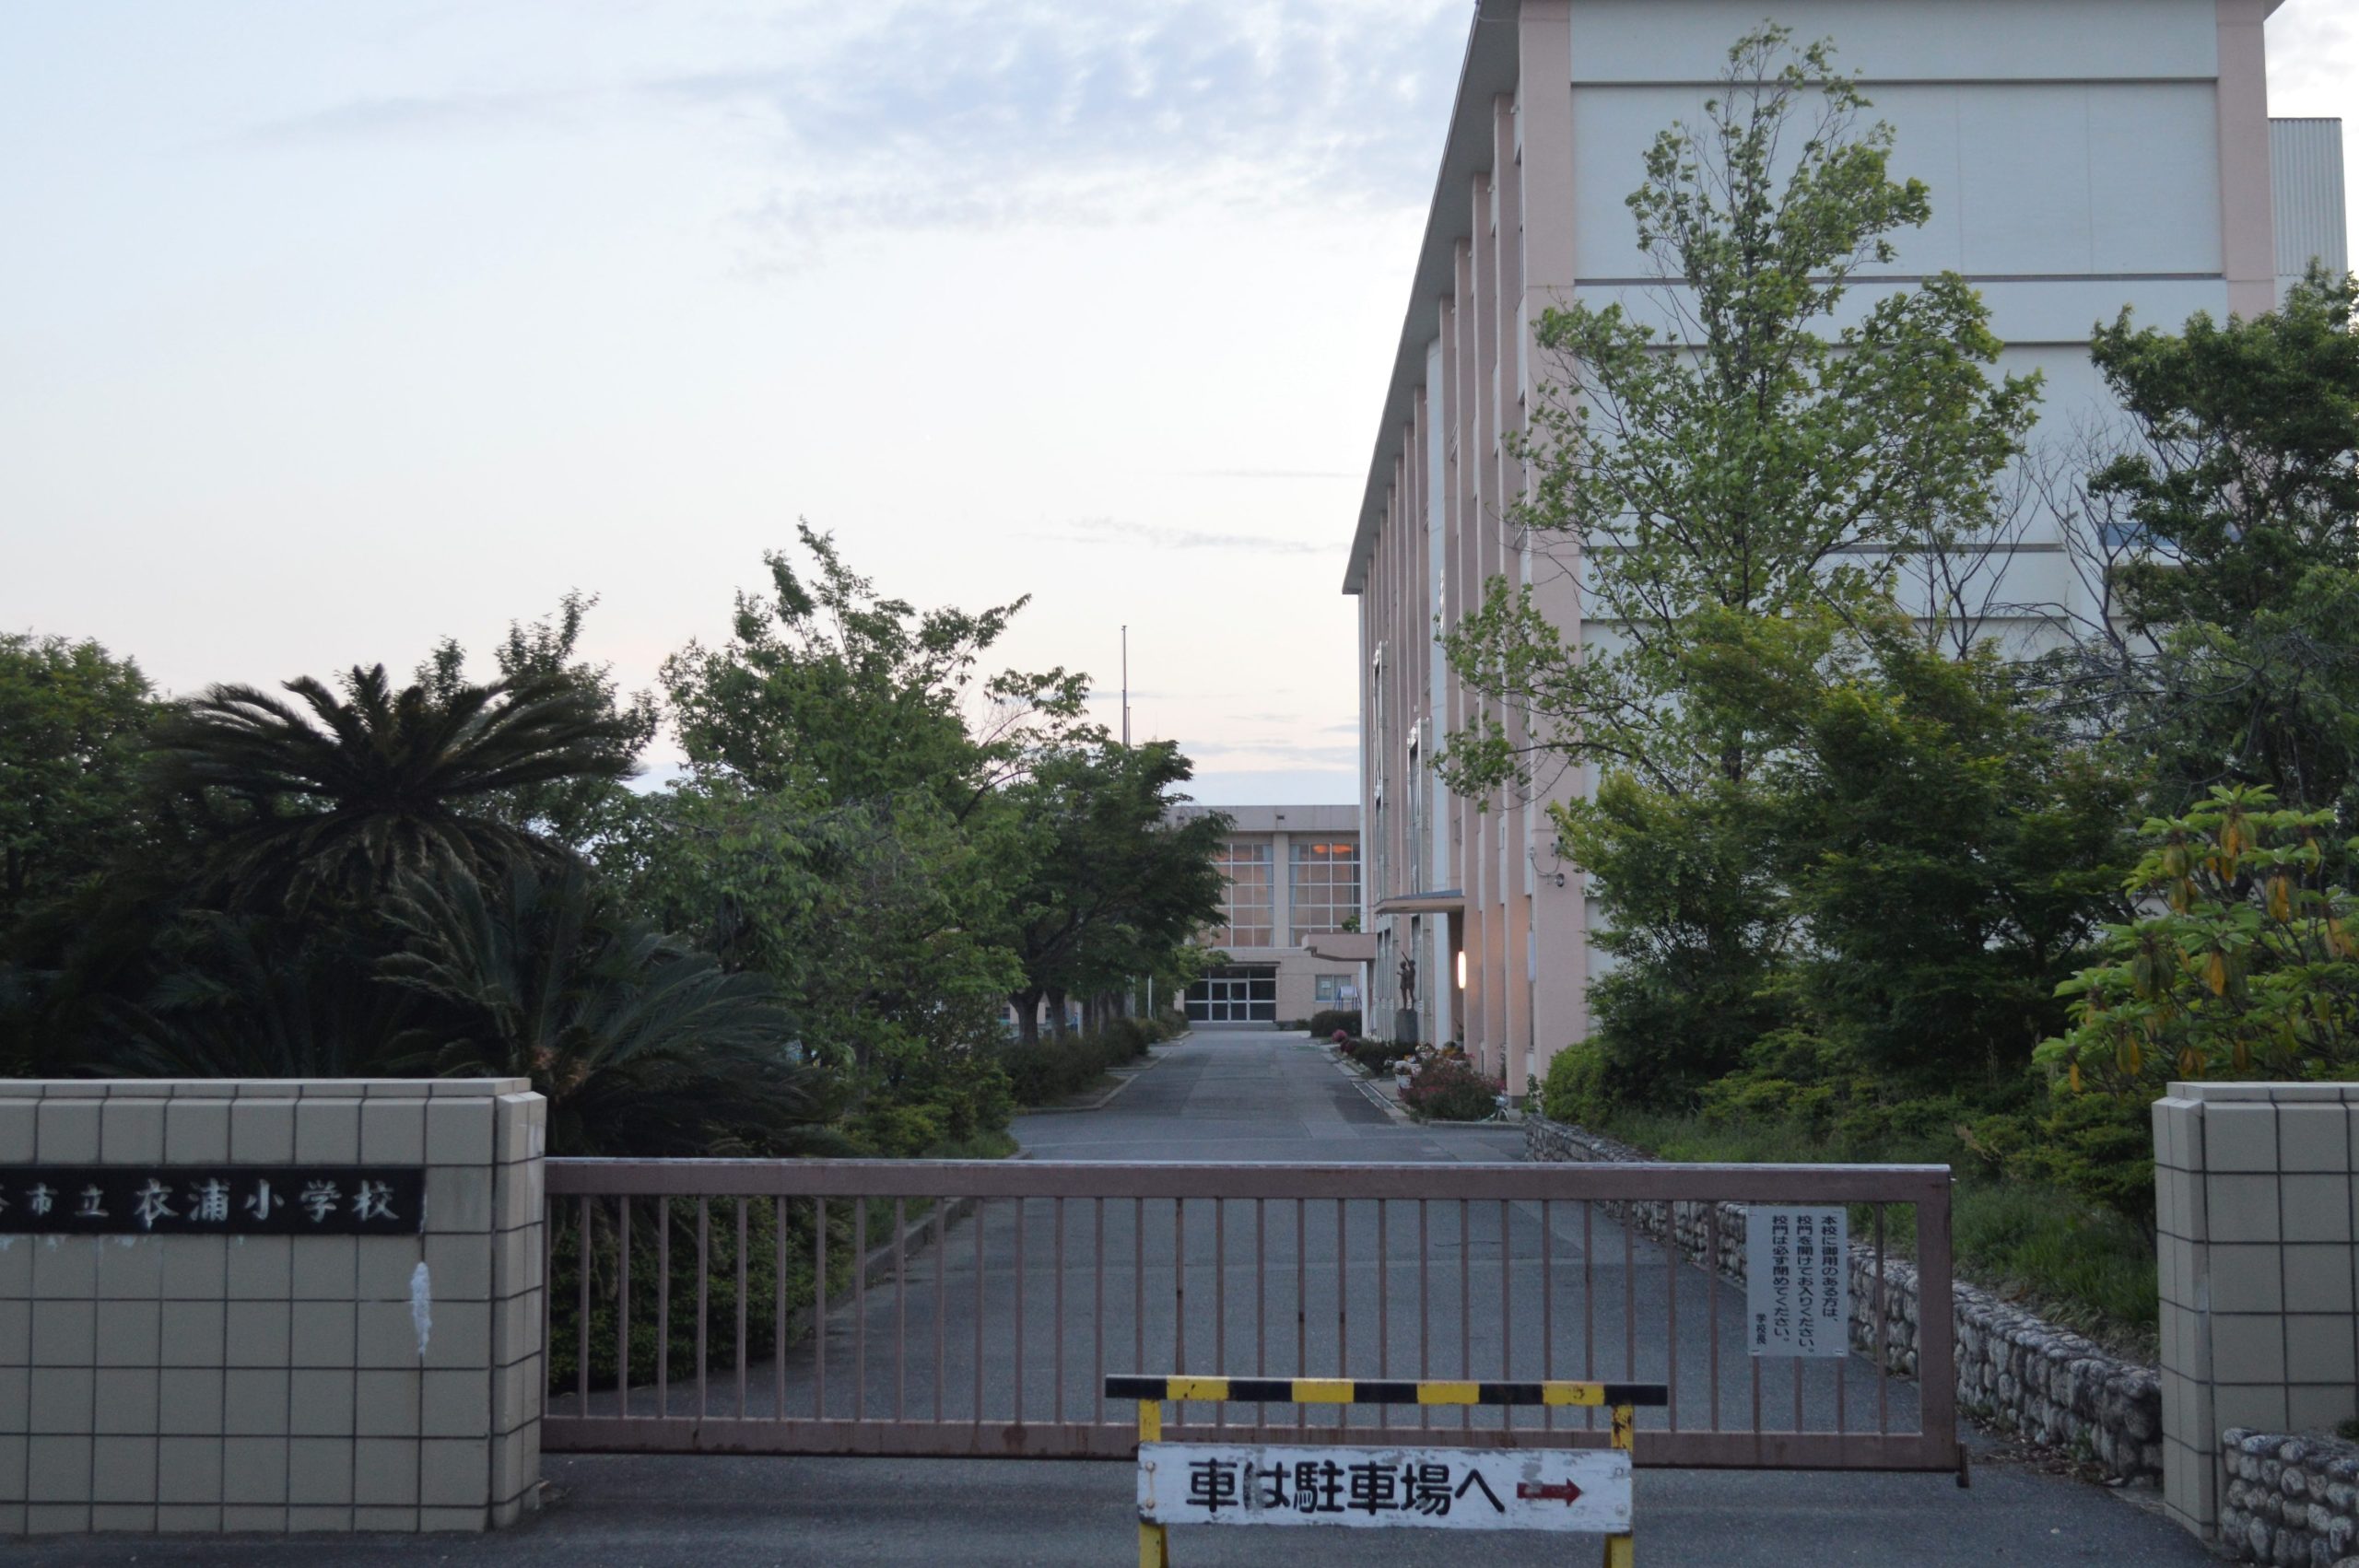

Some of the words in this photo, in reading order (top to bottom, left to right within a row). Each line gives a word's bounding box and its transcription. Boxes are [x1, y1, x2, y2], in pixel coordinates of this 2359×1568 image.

[0, 1176, 400, 1223] 市立衣浦小学校
[1186, 1457, 1506, 1515] 車は駐車場へ
